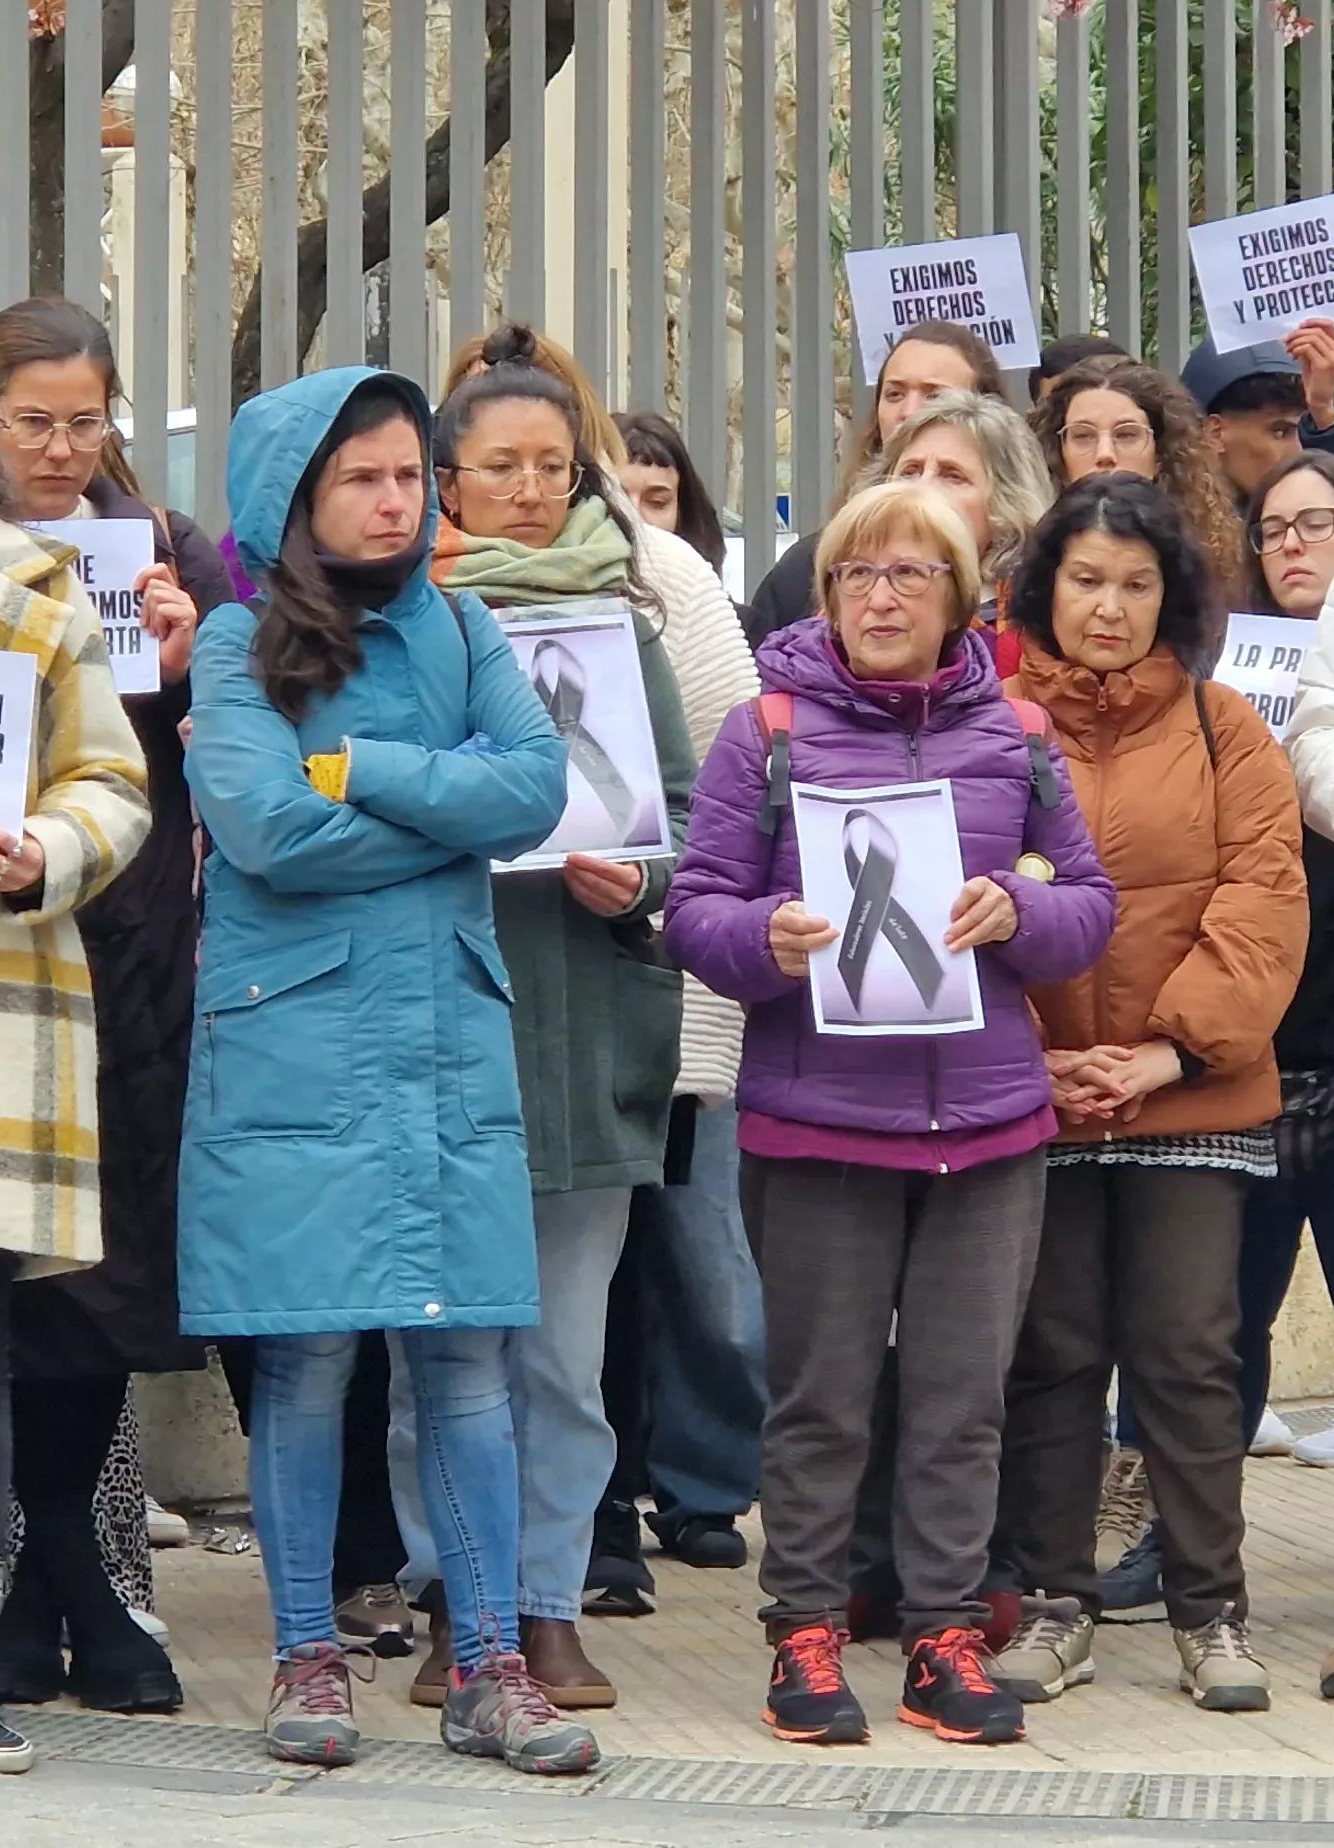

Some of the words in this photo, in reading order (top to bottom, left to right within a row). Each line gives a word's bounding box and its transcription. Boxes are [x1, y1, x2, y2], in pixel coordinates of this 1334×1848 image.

[1238, 217, 1330, 261] EXIGIMOS
[889, 258, 978, 294] EXIGIMOS
[892, 290, 986, 326] DERECHOS
[1233, 299, 1247, 325] Y
[1231, 643, 1263, 668] LA
